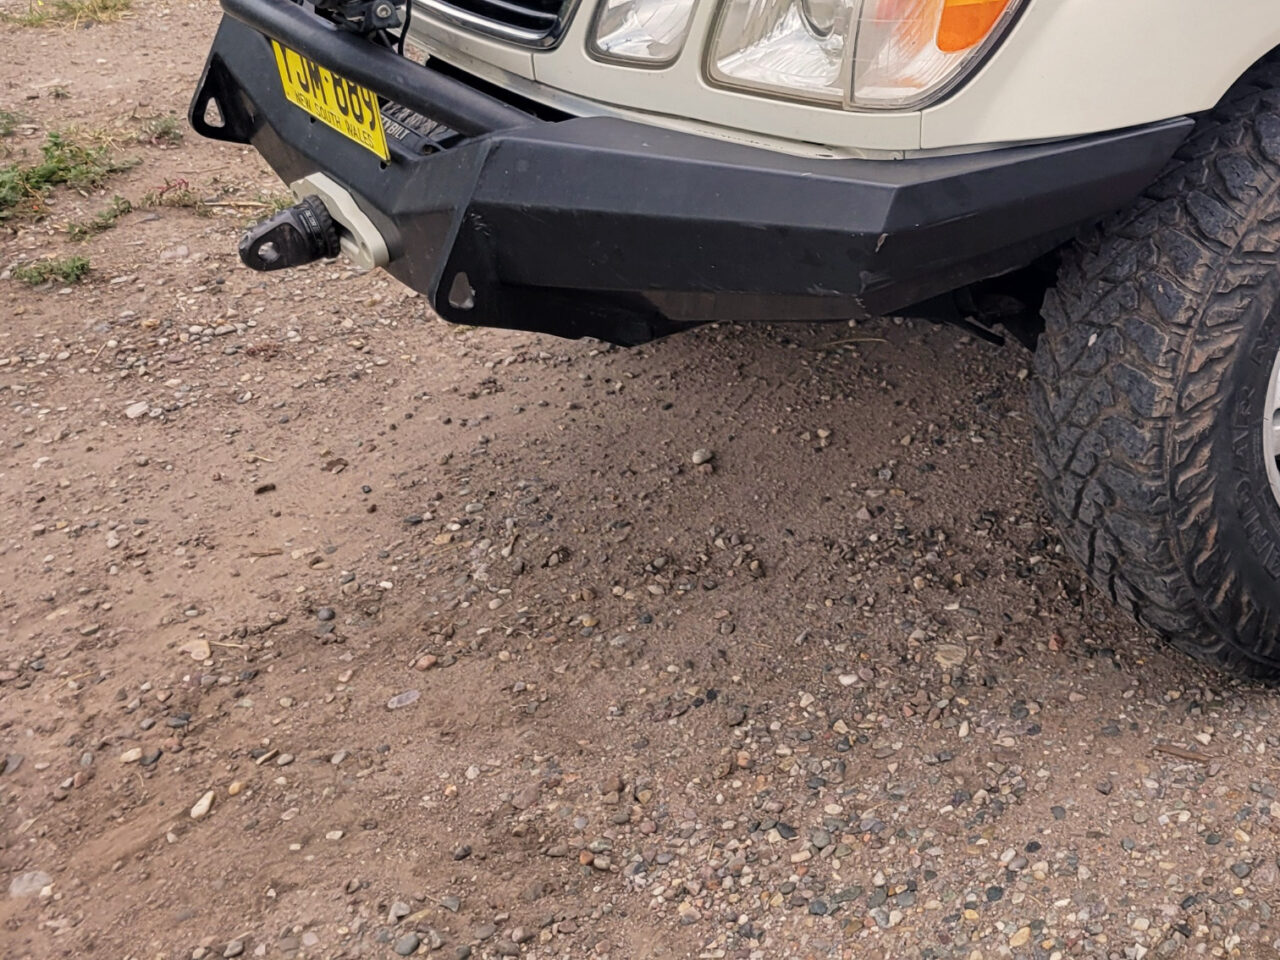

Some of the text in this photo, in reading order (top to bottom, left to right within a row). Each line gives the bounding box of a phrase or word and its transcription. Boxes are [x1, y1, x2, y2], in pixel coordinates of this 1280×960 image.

[295, 90, 374, 149] NEW SOUTH WALES
